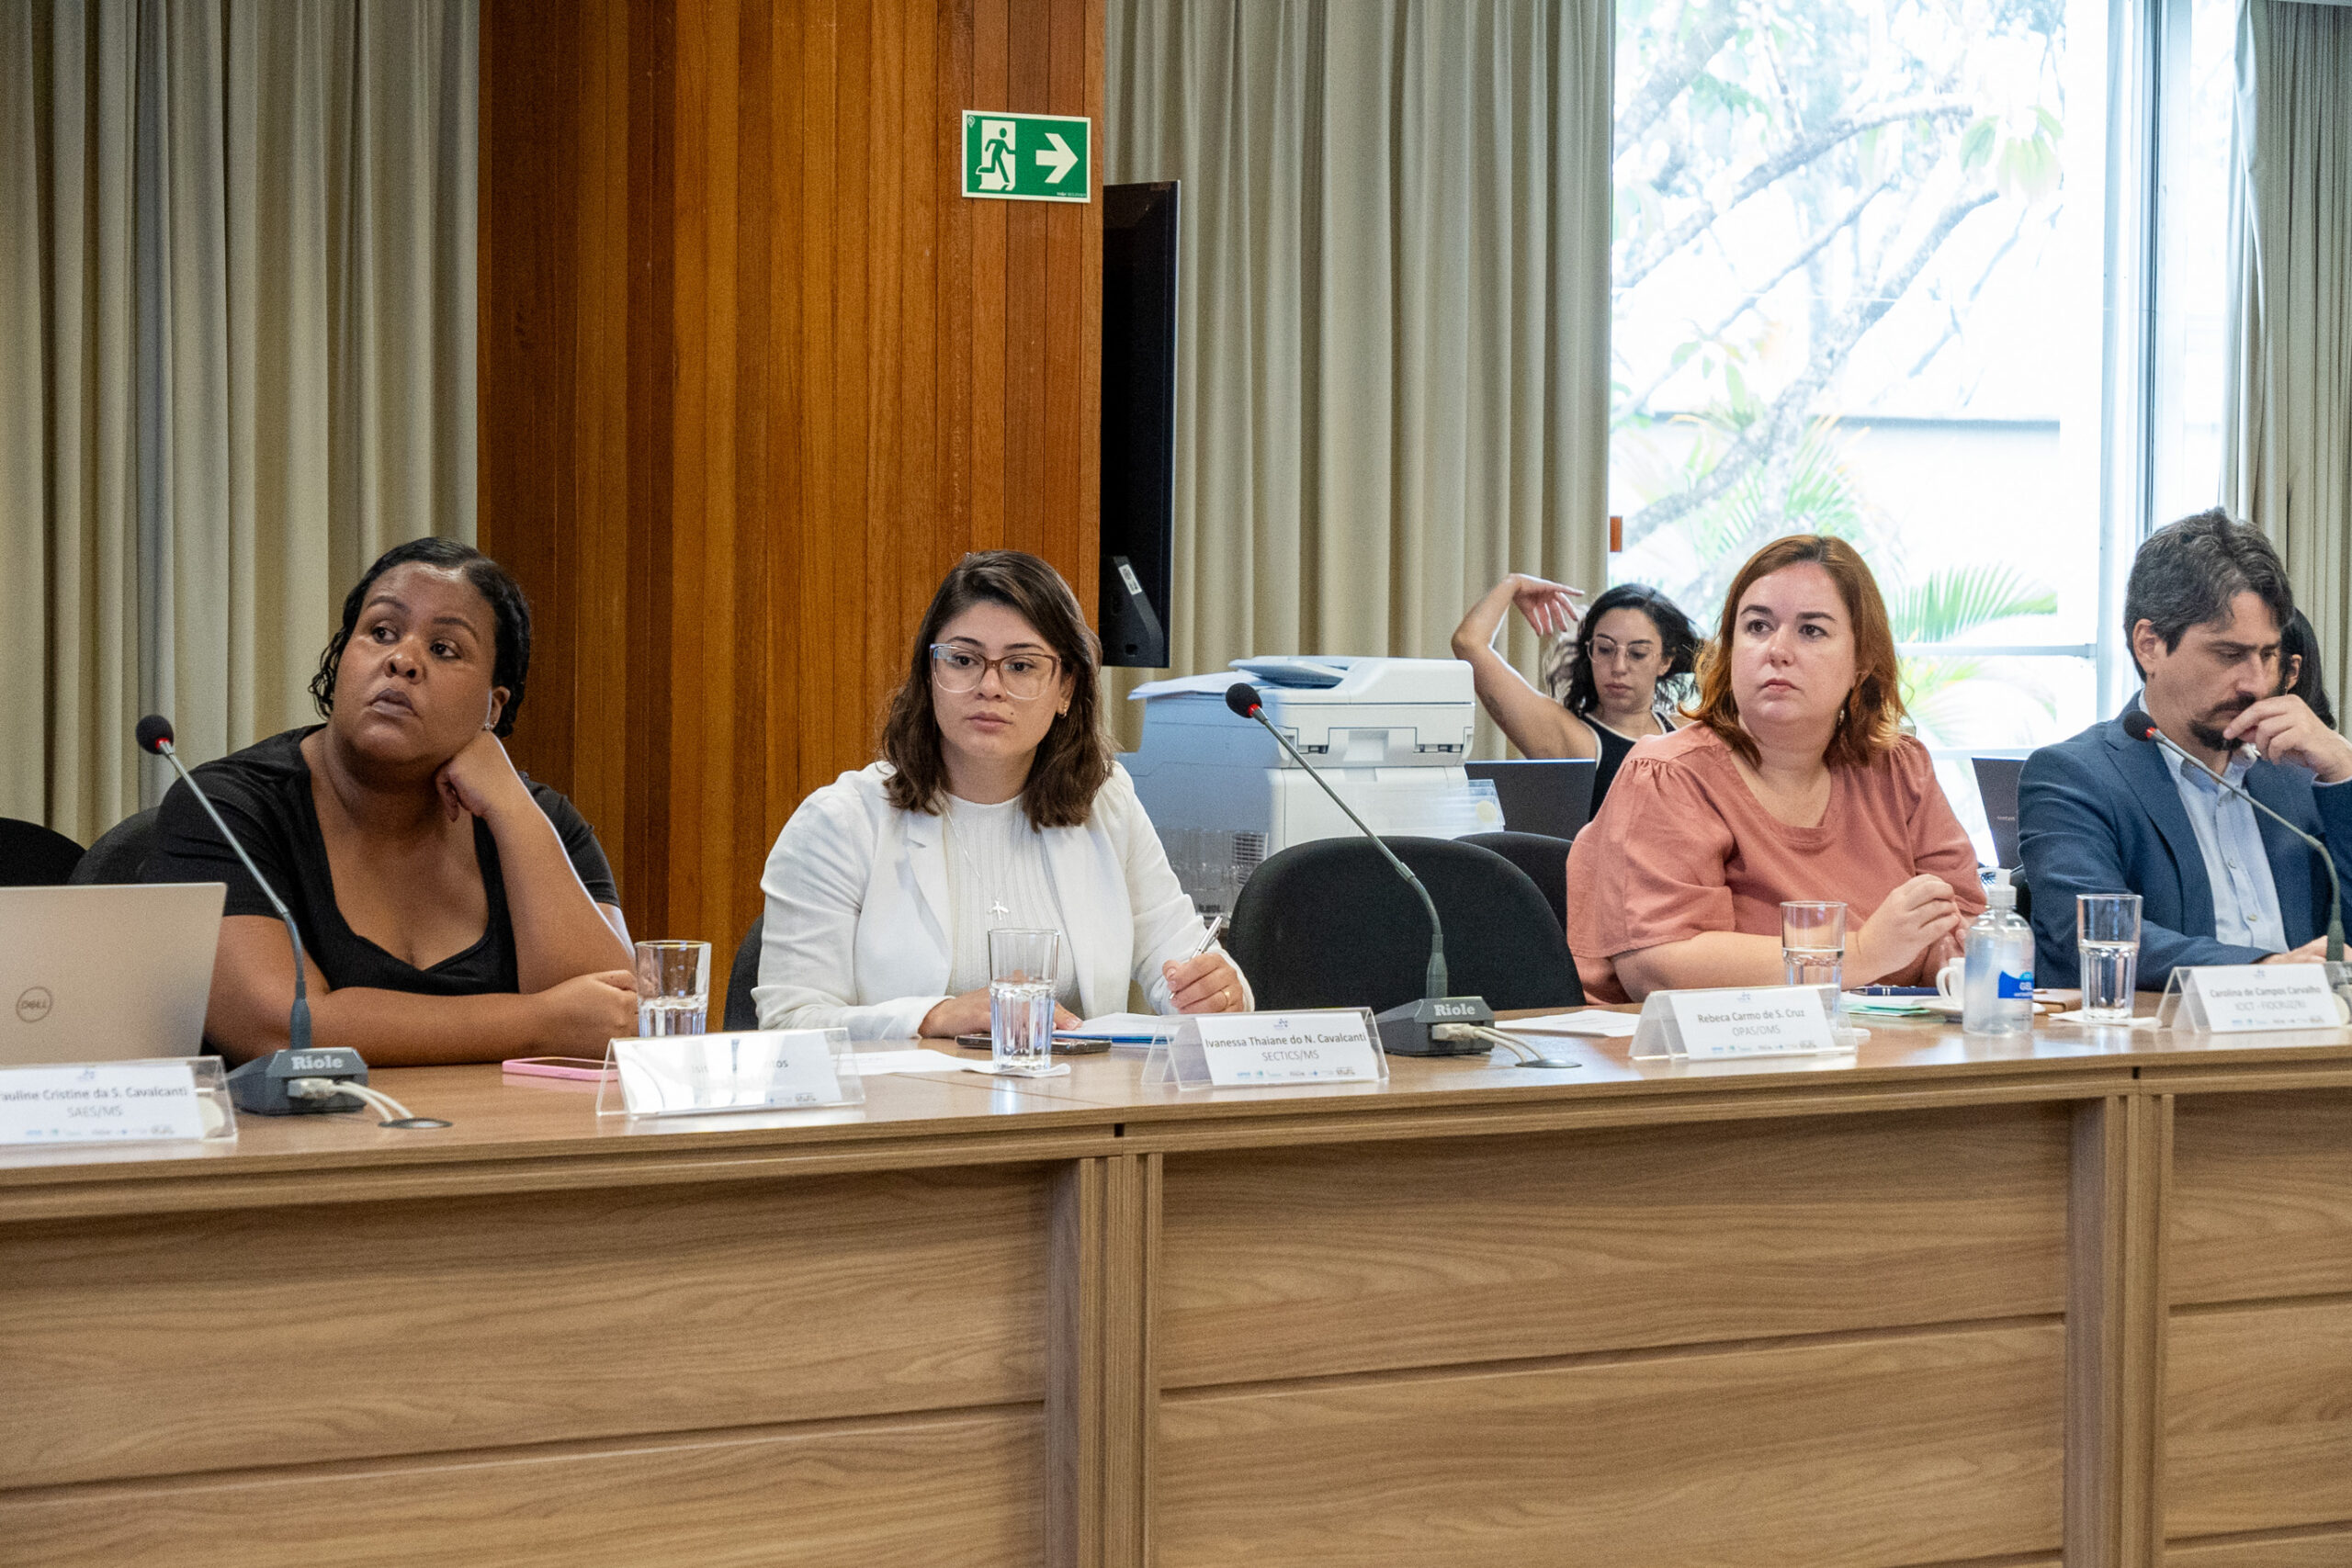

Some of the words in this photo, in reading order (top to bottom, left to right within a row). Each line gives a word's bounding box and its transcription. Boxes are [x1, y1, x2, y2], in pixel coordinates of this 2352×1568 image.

[1433, 1003, 1476, 1016] Riole
[1697, 1012, 1730, 1023] Rebeca
[1732, 1011, 1761, 1021] Carmo
[1762, 1010, 1774, 1020] de
[1785, 1008, 1805, 1018] Cruz
[1205, 1038, 1248, 1048] Ivanessa
[1249, 1034, 1288, 1047] Thaiane
[1290, 1033, 1303, 1044] do
[1304, 1033, 1316, 1044] N.
[1317, 1032, 1367, 1043] Cavalcanti
[291, 1054, 344, 1070] Riole
[1261, 1049, 1320, 1062] SECTICS/MS
[0, 1089, 39, 1101] auline
[42, 1088, 89, 1101] Cristine
[93, 1087, 108, 1099] da
[110, 1087, 122, 1099] S.
[125, 1084, 187, 1098] Cavalcanti
[67, 1104, 123, 1119] SAES/MS
